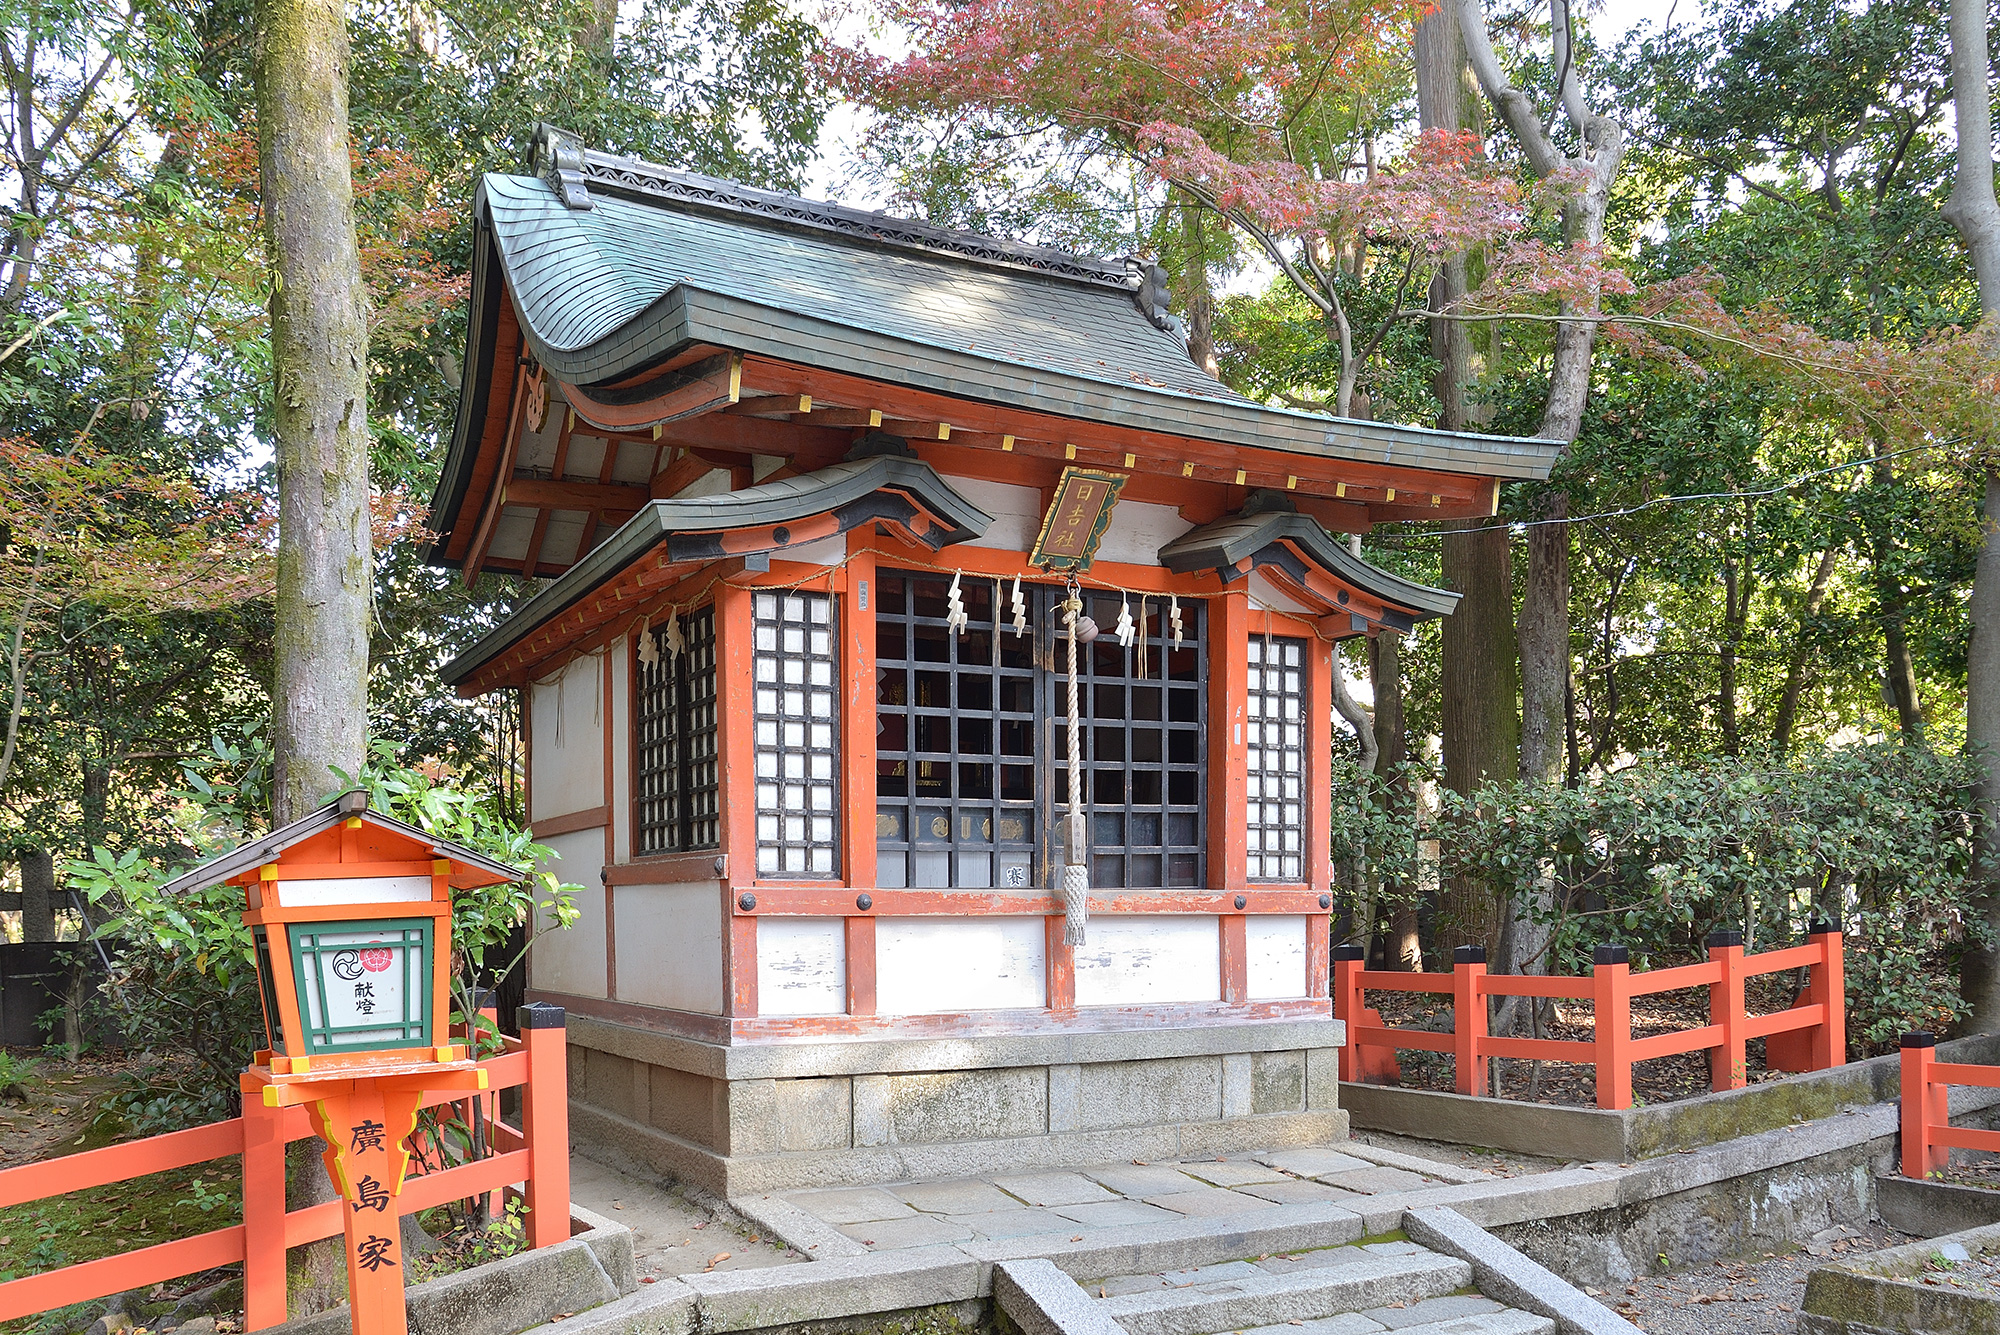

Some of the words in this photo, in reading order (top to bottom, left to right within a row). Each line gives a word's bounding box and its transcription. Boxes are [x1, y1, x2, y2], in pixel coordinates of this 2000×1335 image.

[1054, 484, 1094, 549] 日吉社
[354, 980, 376, 1015] 献燈
[350, 1119, 397, 1273] 廣島家
